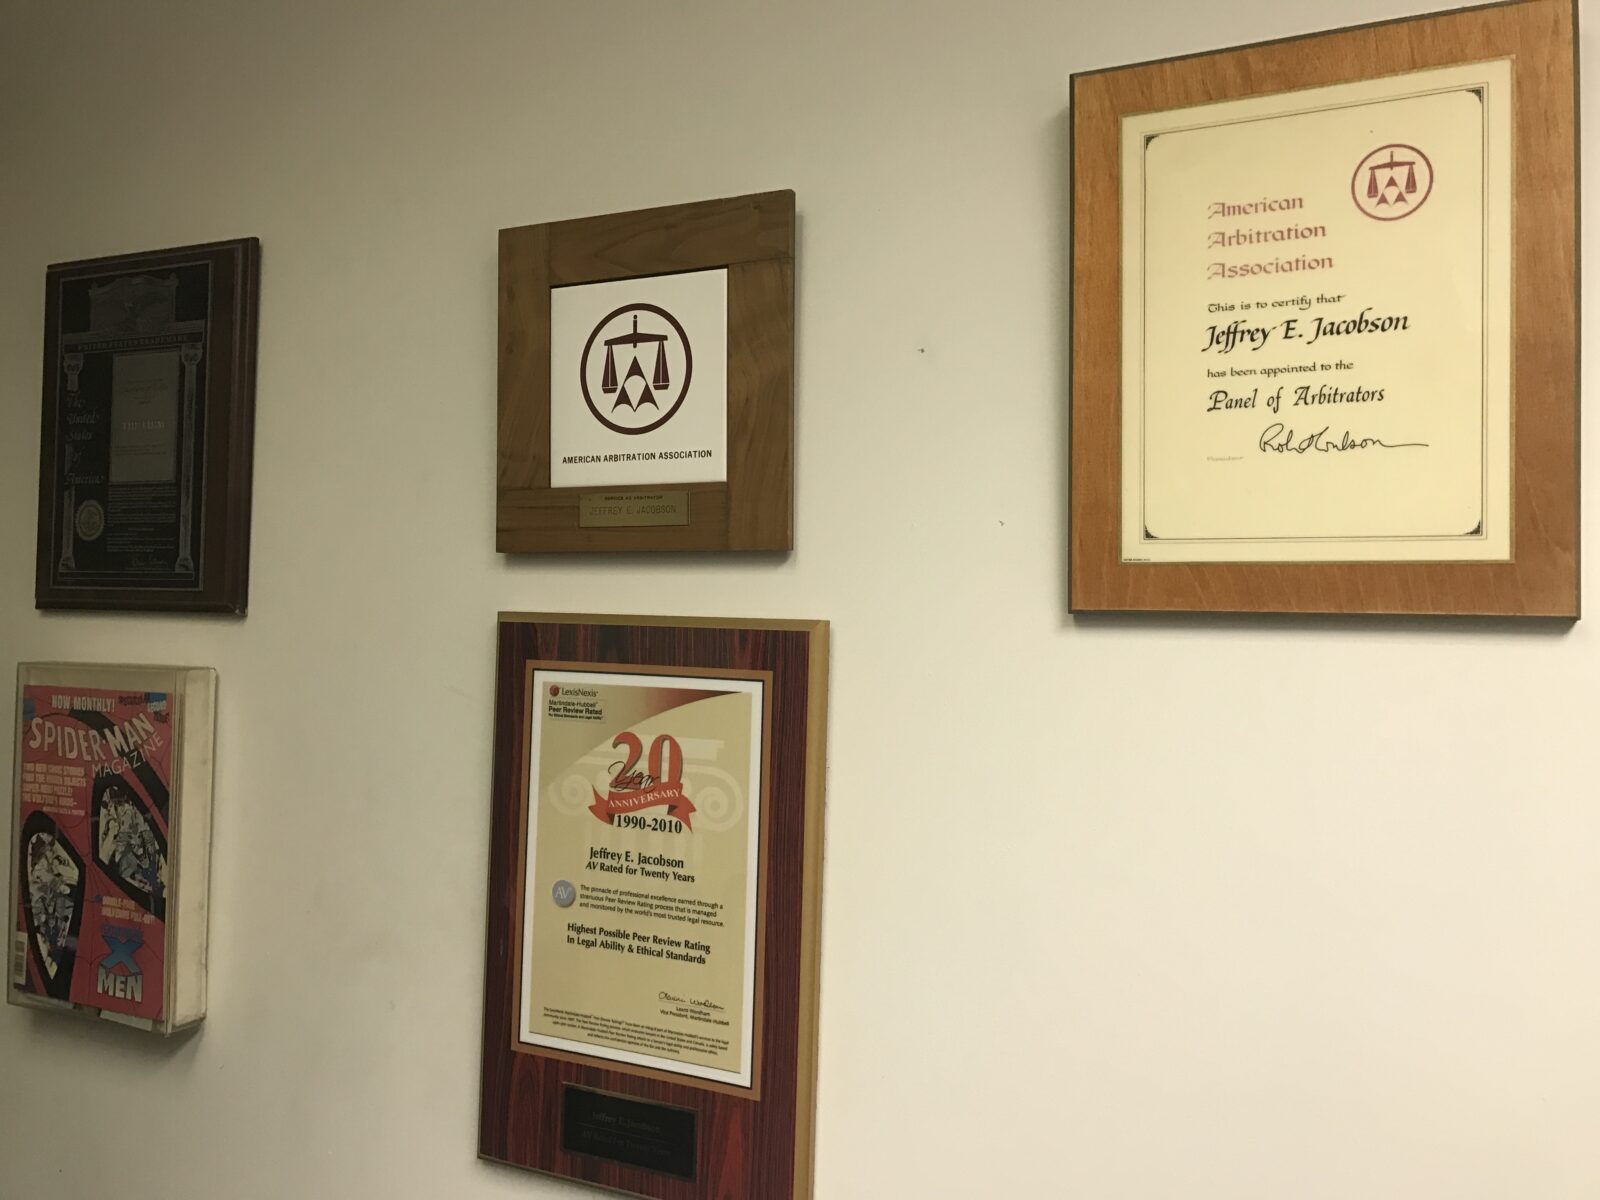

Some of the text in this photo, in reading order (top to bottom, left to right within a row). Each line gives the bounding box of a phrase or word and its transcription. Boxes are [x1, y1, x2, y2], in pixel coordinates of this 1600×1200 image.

[1207, 196, 1304, 219] American
[1207, 223, 1327, 249] Arbitration
[1207, 254, 1334, 280] Association
[1207, 293, 1347, 314] This is to certify that
[1202, 306, 1411, 353] Jeffrey E. Jacobson
[1206, 359, 1354, 378] has been appointed to the
[1206, 384, 1385, 413] Panel of Arbitrators
[562, 449, 713, 465] AMERICAN ARBITRATION ASSOCIATION
[589, 505, 622, 516] JEFFREY
[637, 503, 676, 514] JACOBSON
[51, 695, 71, 710] NOW
[73, 696, 116, 713] MONTHLY!
[548, 705, 603, 716] Peer Review Rated
[92, 732, 163, 779] MAGAZINE
[609, 731, 684, 790] 20
[608, 760, 661, 793] Year
[608, 789, 680, 808] ANNIVERSARY
[615, 814, 682, 834] 1990-2010
[589, 846, 684, 868] Jeffrey E. Jacobson
[585, 861, 695, 883] AV Rated for Twenty Years
[555, 886, 570, 899] AV
[580, 884, 590, 892] The
[591, 886, 612, 895] pinnacle
[613, 887, 619, 895] of
[619, 889, 650, 900] professional
[651, 894, 677, 903] excellence
[678, 897, 696, 906] earned
[697, 899, 718, 909] through
[580, 892, 604, 902] strenuous
[605, 895, 616, 904] Peer
[617, 897, 636, 906] Review
[636, 900, 653, 909] Rating
[654, 904, 674, 913] process
[692, 909, 717, 918] managed
[590, 903, 616, 912] monitored
[634, 909, 652, 917] world's
[667, 914, 686, 922] trusted
[687, 915, 700, 924] legal
[700, 919, 724, 927] resource.
[567, 922, 710, 954] Highest Possible Peer Review Rating
[567, 935, 706, 965] In Legal Ability & Ethical Standards
[101, 934, 144, 973] X
[97, 963, 143, 1003] MEN
